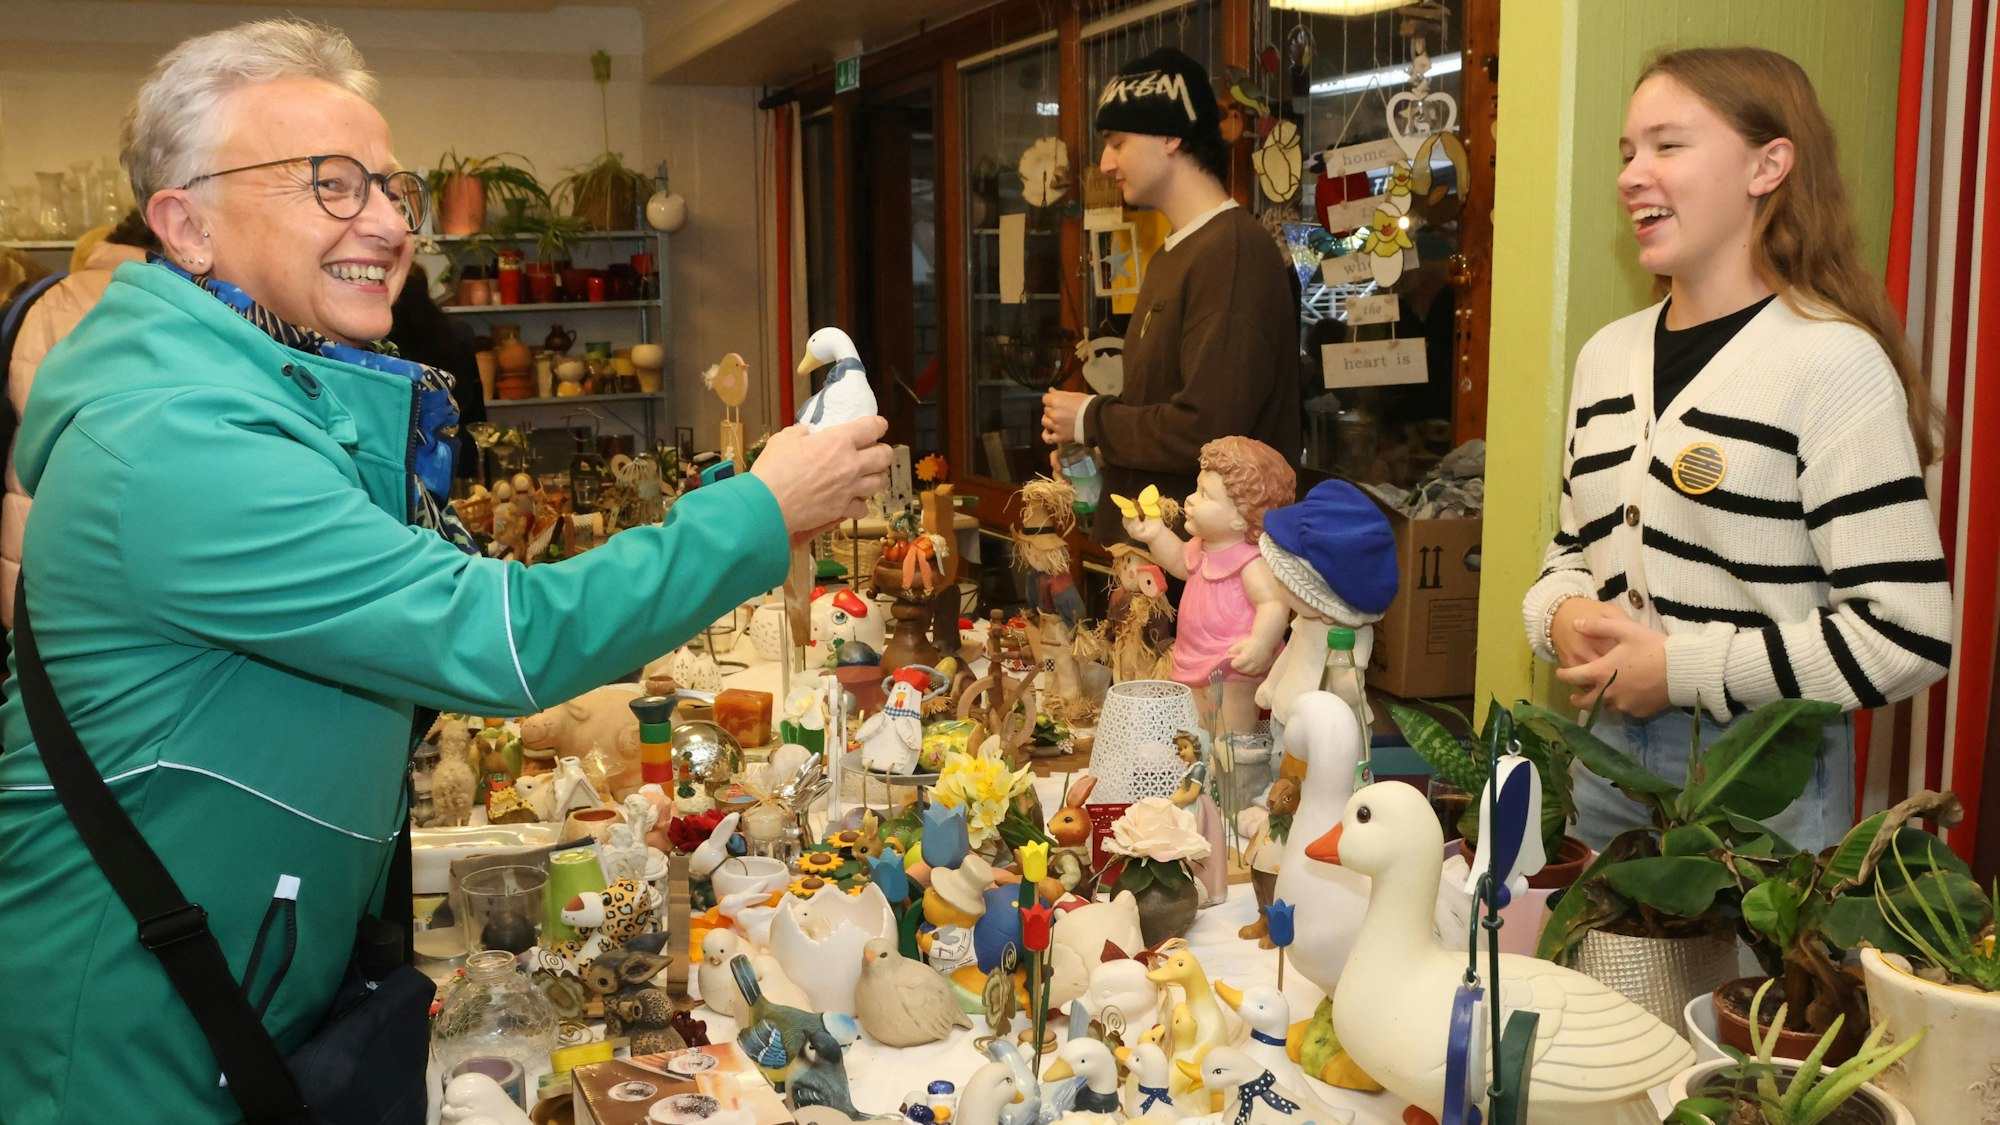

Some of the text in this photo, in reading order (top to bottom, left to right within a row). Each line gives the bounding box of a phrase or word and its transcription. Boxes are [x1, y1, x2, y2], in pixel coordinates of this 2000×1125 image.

[1342, 148, 1386, 166] home
[1362, 302, 1382, 316] the
[1343, 352, 1411, 371] heart is
